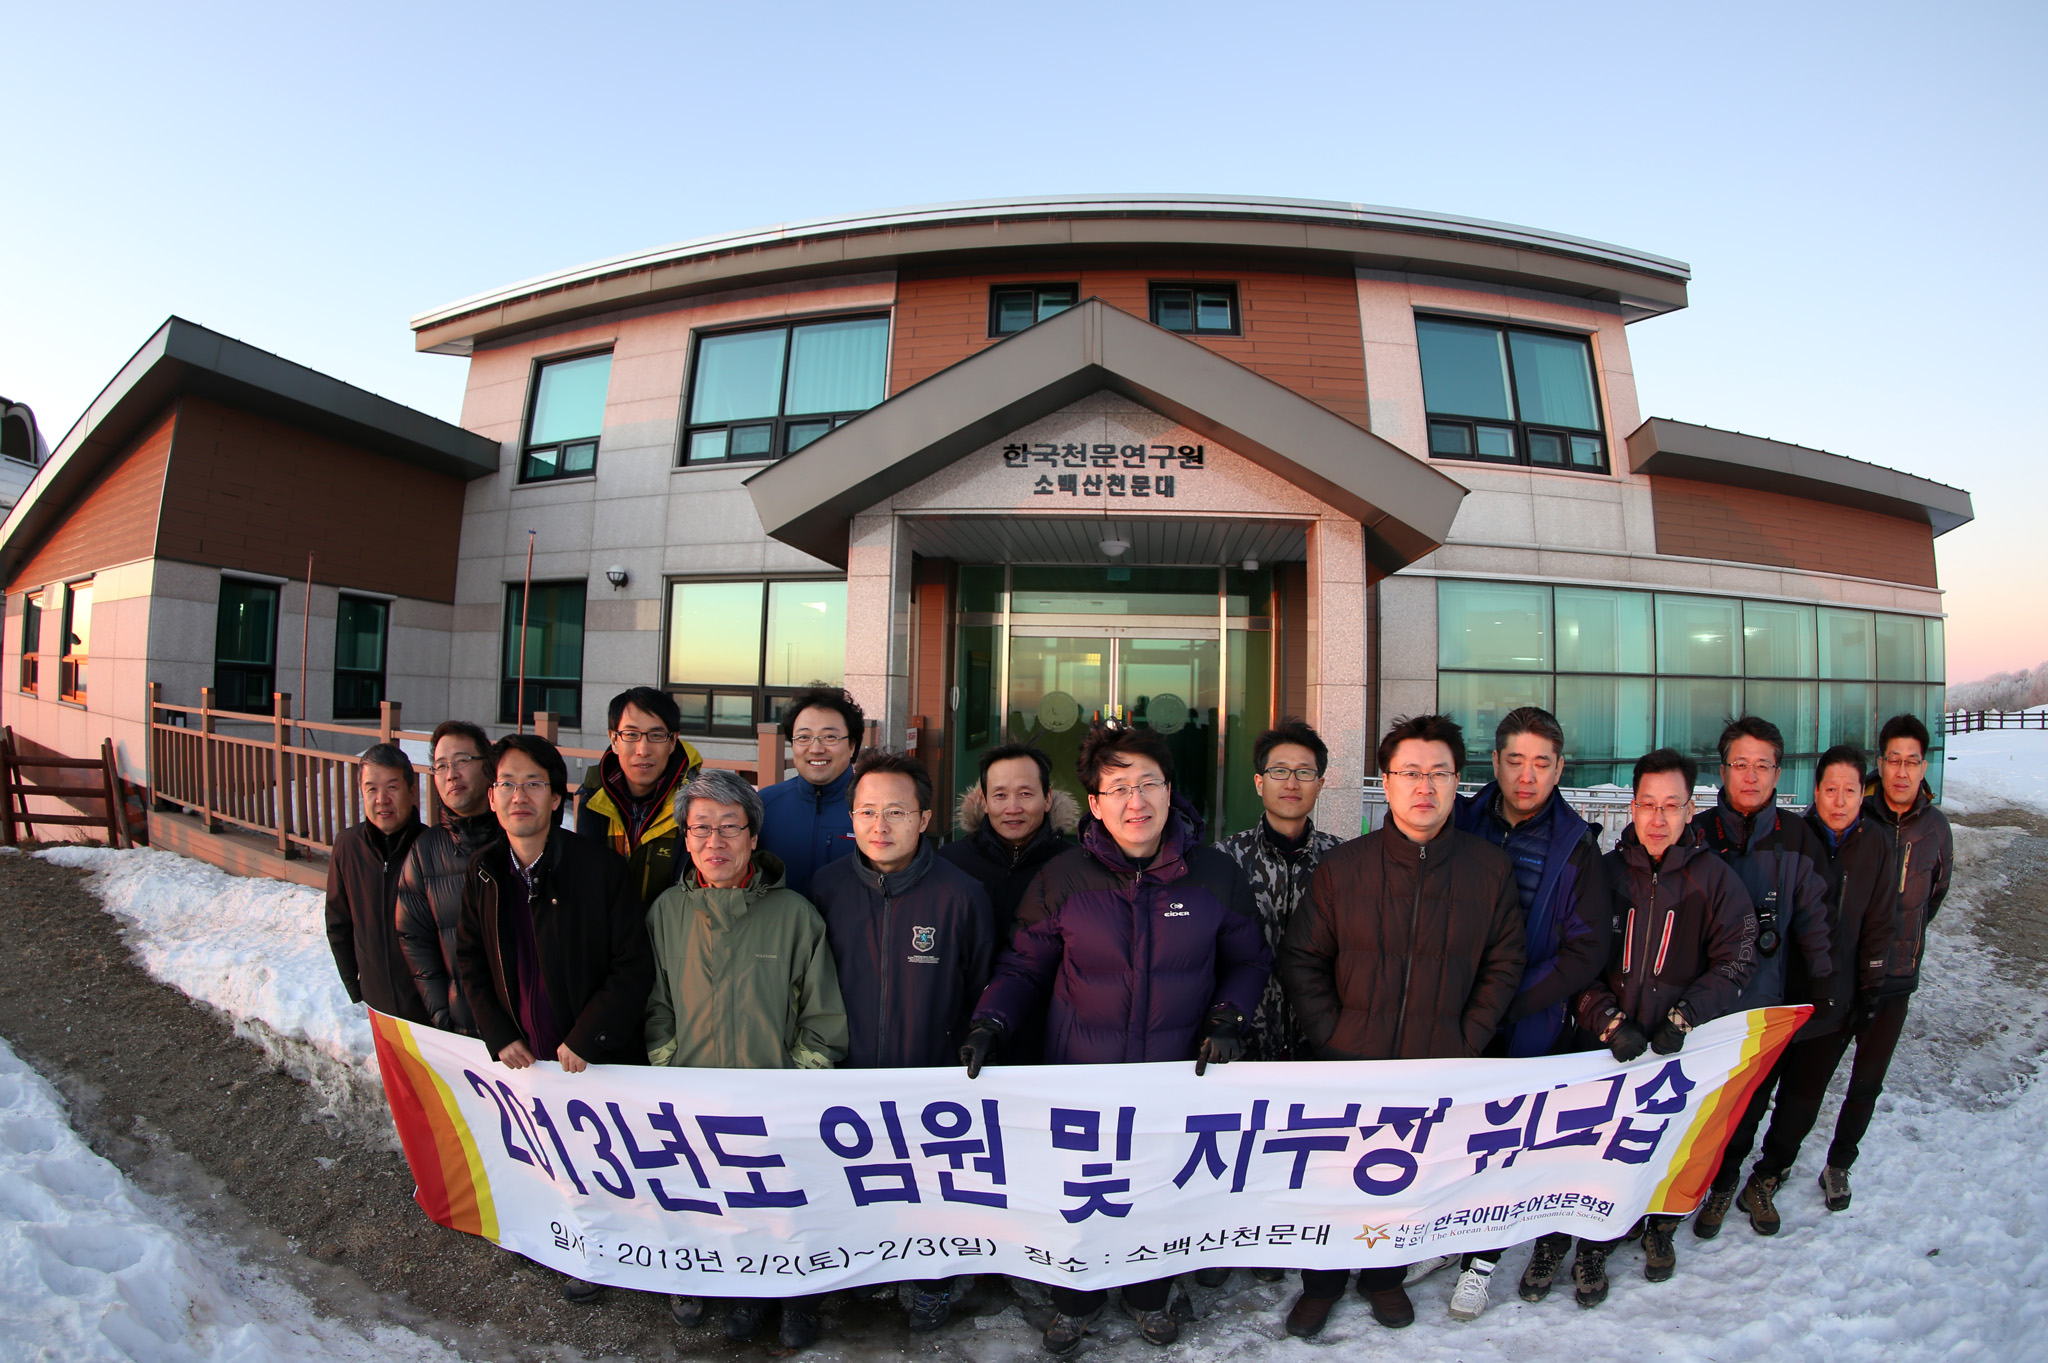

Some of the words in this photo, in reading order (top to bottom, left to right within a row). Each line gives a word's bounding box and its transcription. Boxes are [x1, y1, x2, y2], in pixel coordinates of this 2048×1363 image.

[1003, 442, 1204, 469] 한국천문연구원
[1033, 474, 1175, 498] 소백산천문대
[463, 1069, 808, 1216] 2013년도
[819, 1099, 1008, 1209] 임원
[1050, 1106, 1136, 1223] 및
[1431, 1232, 1448, 1241] The
[1450, 1227, 1481, 1237] Korean
[1576, 1210, 1606, 1223] Society
[618, 1243, 725, 1273] 2013년
[1023, 1245, 1089, 1273] 장소
[1125, 1224, 1331, 1263] 소백산천문대
